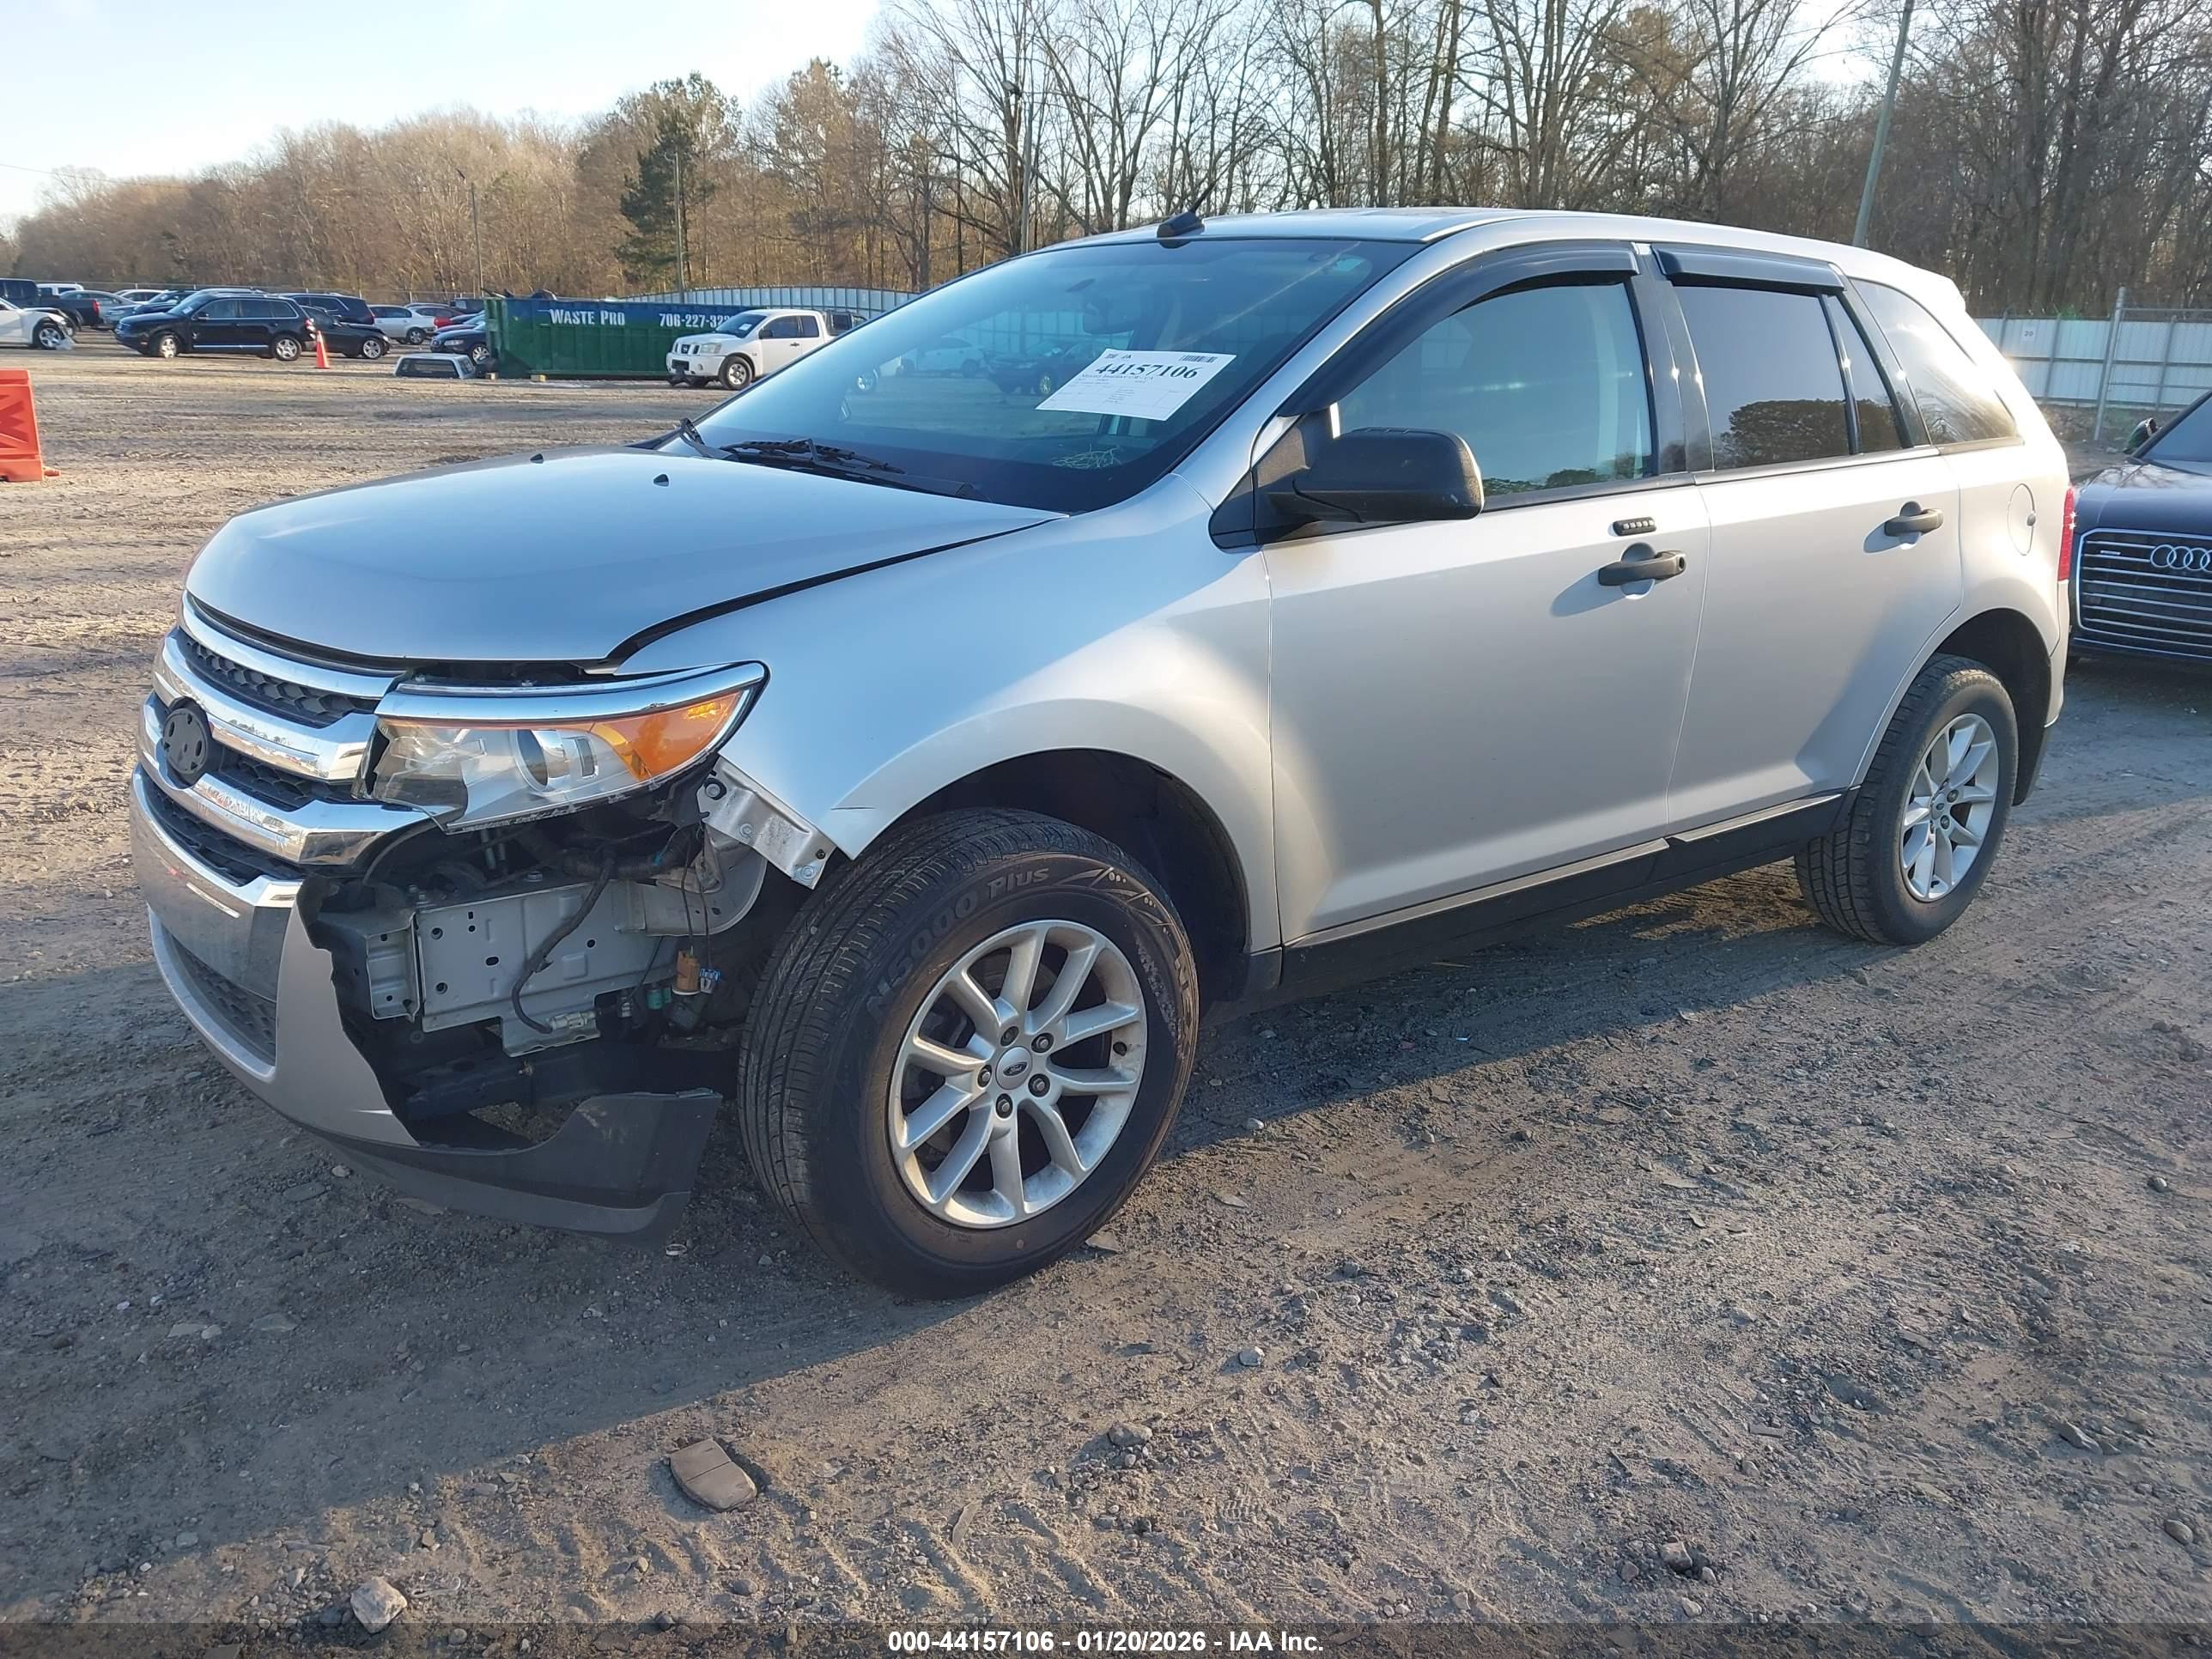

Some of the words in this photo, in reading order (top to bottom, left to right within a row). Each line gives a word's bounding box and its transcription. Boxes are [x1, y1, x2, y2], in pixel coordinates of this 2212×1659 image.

[550, 308, 595, 325] WASTE
[600, 309, 626, 326] PRO
[1095, 362, 1202, 379] 44157106
